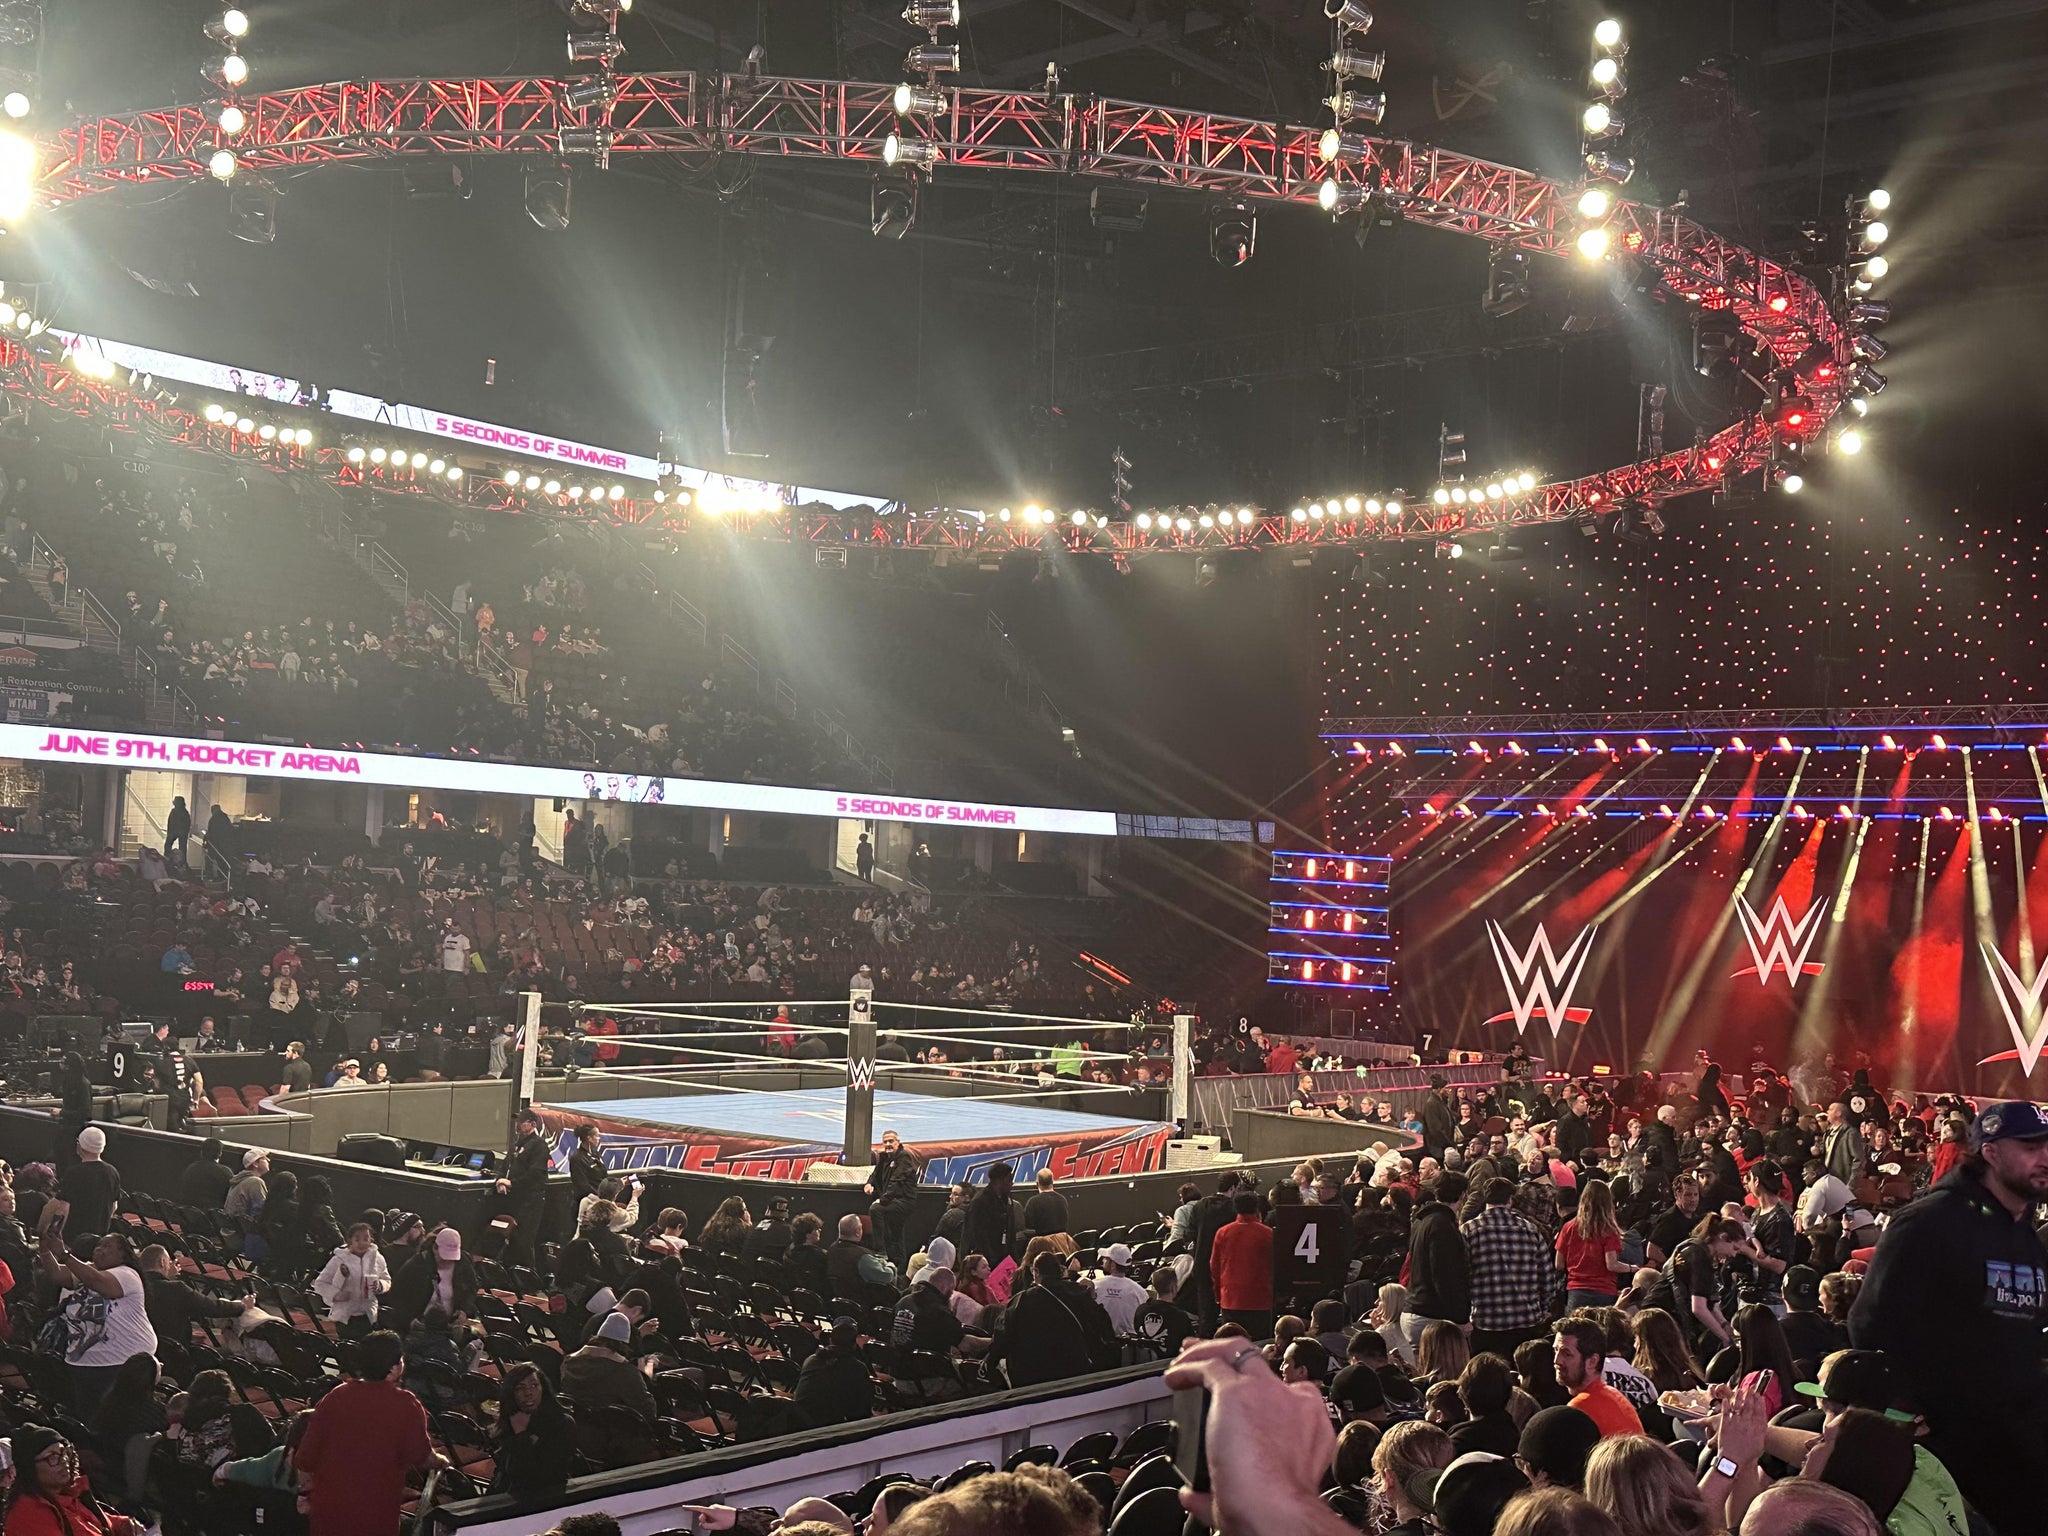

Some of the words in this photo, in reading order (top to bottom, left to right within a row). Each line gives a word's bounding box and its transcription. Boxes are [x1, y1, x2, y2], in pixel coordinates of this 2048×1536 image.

[436, 417, 448, 432] 5
[451, 421, 530, 449] SECONDS
[533, 438, 555, 454] OF
[557, 444, 627, 470] SUMMER
[66, 681, 126, 696] Construtn.
[8, 697, 37, 711] WTAM
[38, 733, 110, 752] JUNE
[115, 738, 171, 762] 9TH,
[176, 743, 276, 768] ROCKET
[280, 751, 361, 775] ARENA
[836, 797, 848, 812] 5
[850, 798, 922, 818] SECONDS
[925, 804, 945, 819] OF
[946, 806, 1016, 825] SUMMER
[1239, 1017, 1248, 1033] 8
[1422, 1034, 1433, 1051] 7
[113, 1052, 125, 1078] 9
[683, 1145, 839, 1182] EVEN
[1050, 1129, 1169, 1181] EVENT
[1294, 1222, 1320, 1264] 4
